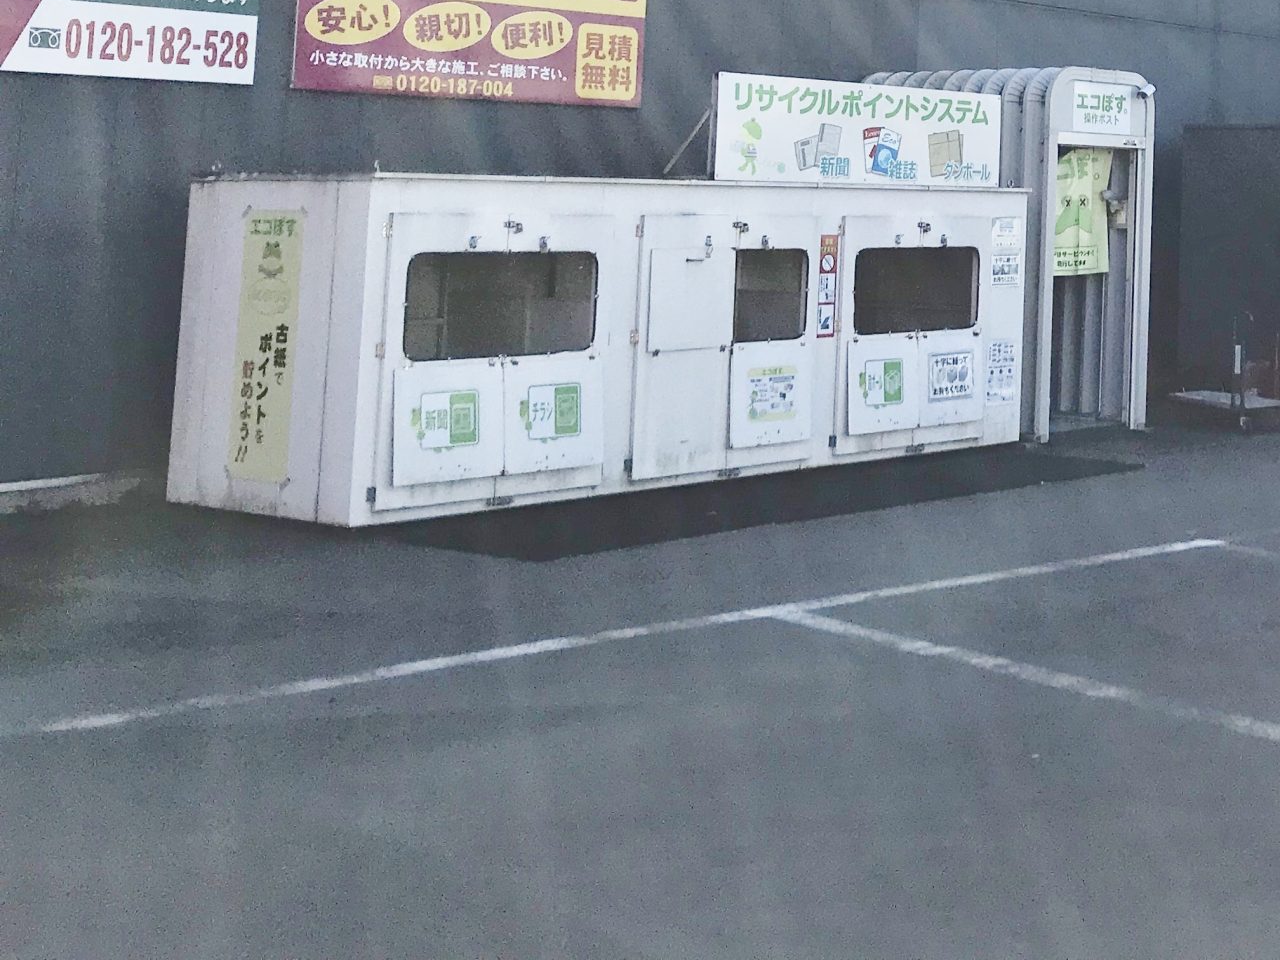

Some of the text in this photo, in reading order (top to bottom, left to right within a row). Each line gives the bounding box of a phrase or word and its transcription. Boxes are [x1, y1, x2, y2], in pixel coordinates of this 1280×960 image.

[316, 3, 392, 35] 安心!
[415, 12, 484, 43] 親切!
[65, 18, 250, 70] 0120-182-528
[501, 20, 565, 52] 便利!
[581, 32, 634, 63] 見積
[396, 74, 514, 97] 0120-187-004
[581, 63, 633, 93] 無料
[734, 82, 989, 126] リサイクルポイントシステム
[820, 156, 850, 177] 新聞
[888, 160, 917, 180] 雑誌
